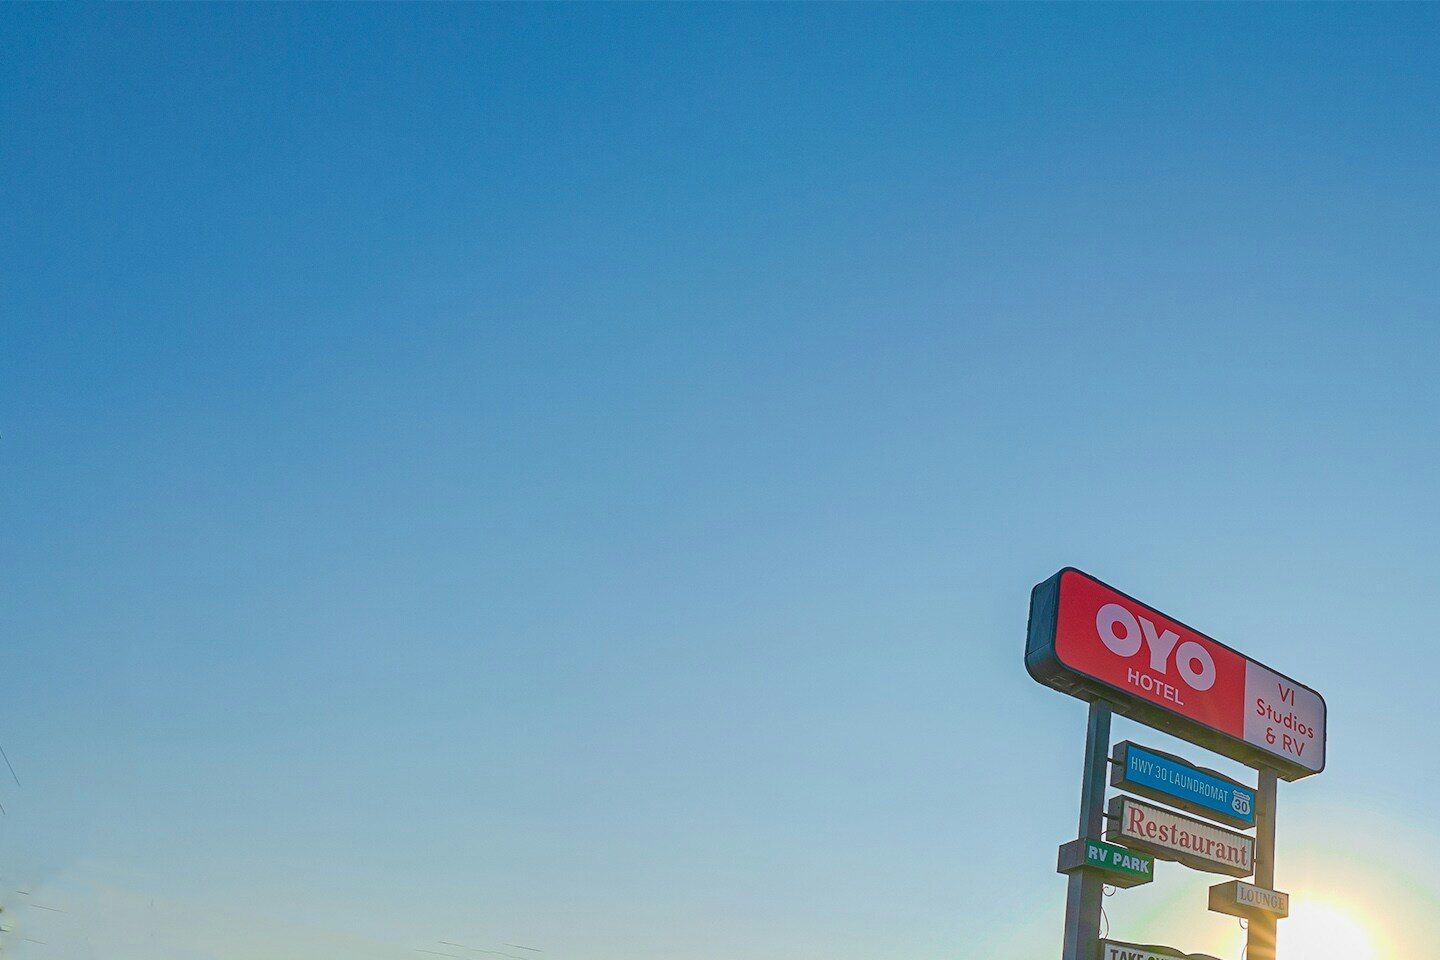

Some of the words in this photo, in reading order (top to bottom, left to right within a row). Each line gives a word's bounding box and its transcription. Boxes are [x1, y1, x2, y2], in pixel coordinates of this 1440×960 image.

[1095, 602, 1217, 692] OYO
[1127, 667, 1184, 706] HOTEL
[1278, 683, 1294, 706] VI
[1256, 698, 1314, 739] Studios
[1266, 727, 1276, 744] &
[1283, 733, 1305, 756] RV
[1131, 756, 1153, 776] HWY
[1155, 765, 1167, 780] 30
[1169, 770, 1229, 803] LAUNDROMAT
[1234, 799, 1248, 812] 30
[1126, 805, 1248, 867] Restaurant
[1088, 845, 1108, 862] RV
[1112, 851, 1150, 874] PARK
[1239, 889, 1285, 910] LOUNGE
